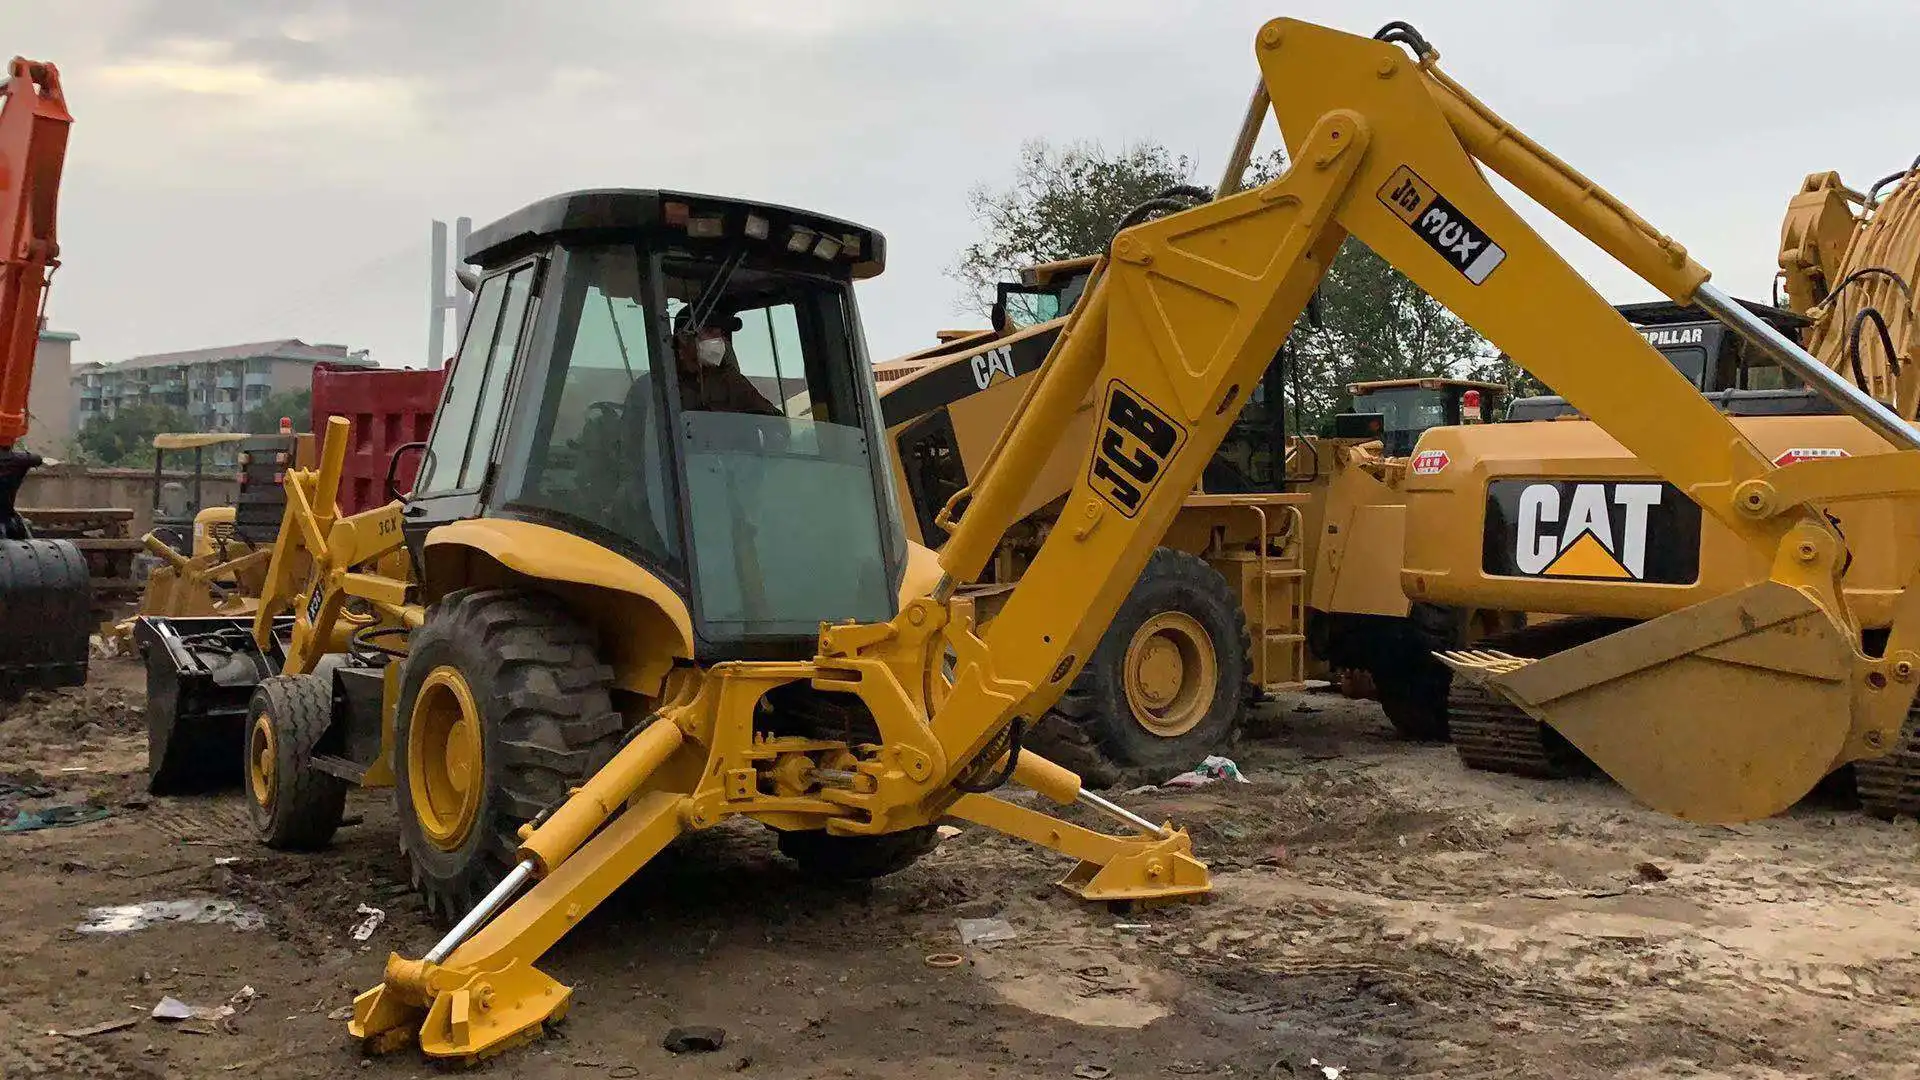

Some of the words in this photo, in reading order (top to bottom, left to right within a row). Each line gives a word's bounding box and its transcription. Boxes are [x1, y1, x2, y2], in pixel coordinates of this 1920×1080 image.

[1391, 178, 1421, 212] JCB
[970, 344, 1015, 390] CAT
[1094, 389, 1177, 509] JCB
[1516, 484, 1662, 579] CAT
